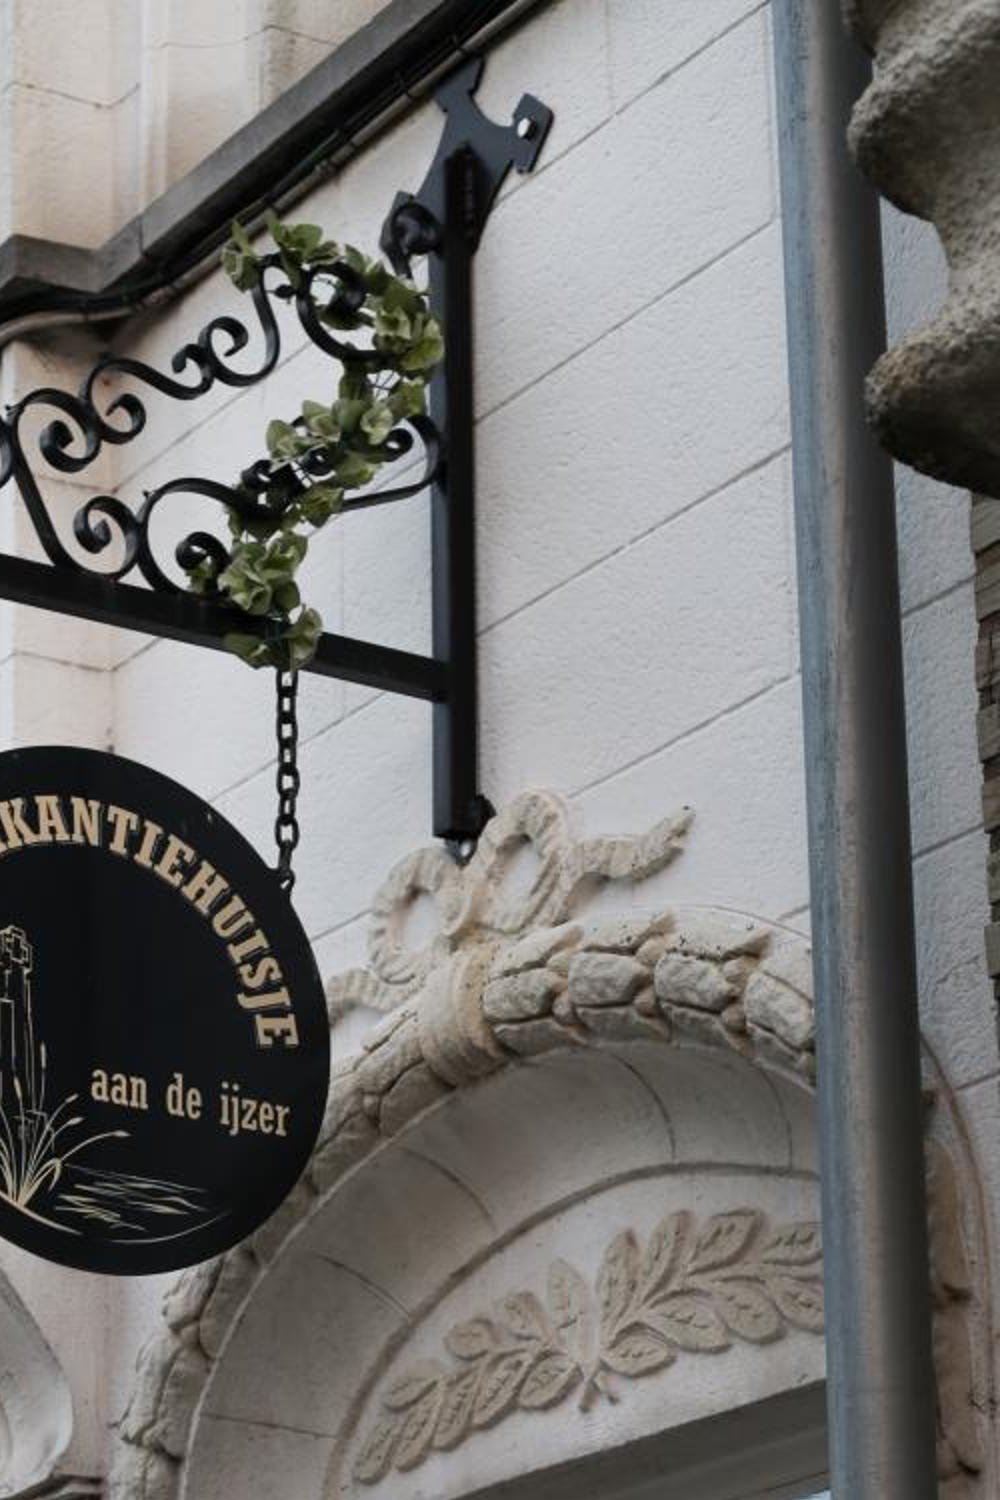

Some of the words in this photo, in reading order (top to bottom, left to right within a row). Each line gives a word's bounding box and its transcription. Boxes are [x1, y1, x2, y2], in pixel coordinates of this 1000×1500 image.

[90, 1068, 149, 1110] aan
[166, 1072, 202, 1120] de
[219, 1081, 291, 1138] ijzer
